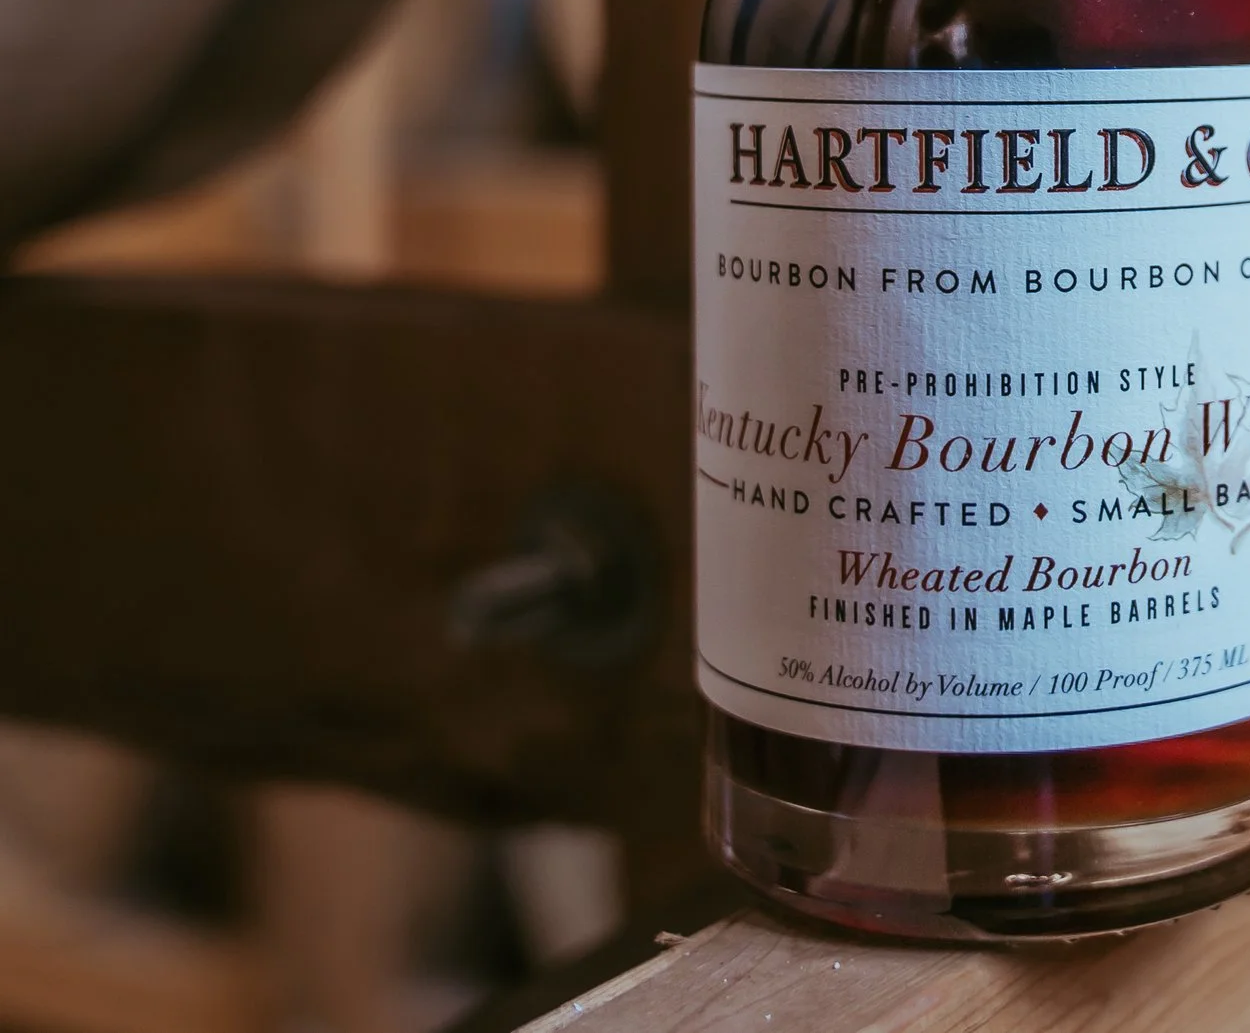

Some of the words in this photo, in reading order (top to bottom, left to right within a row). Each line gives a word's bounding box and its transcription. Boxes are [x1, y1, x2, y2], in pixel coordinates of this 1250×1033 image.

[730, 123, 1156, 193] HARTFIELD
[1180, 124, 1229, 188] &
[718, 253, 856, 292] BOURBON
[882, 268, 996, 294] FROM
[1025, 260, 1219, 294] BOURBON
[839, 368, 1099, 397] PRE-PROHIBITION
[1119, 363, 1195, 392] STYLE
[884, 410, 1174, 473] Bourbon
[733, 478, 810, 514] HAND
[828, 495, 1010, 526] CRAFTED
[1072, 489, 1195, 523] SMALL
[837, 550, 1013, 593] Wheated
[1022, 547, 1192, 592] Bourbon
[809, 595, 931, 630] FINISHED
[950, 607, 977, 631] IN
[999, 604, 1090, 631] MAPLE
[1111, 586, 1220, 624] BARRELS
[778, 656, 814, 682] 50%
[818, 665, 900, 693] Alcohol
[905, 672, 933, 702] by
[937, 674, 1023, 697] Volume
[1048, 672, 1088, 695] 100
[1095, 661, 1163, 692] Proof
[1177, 653, 1214, 680] 375
